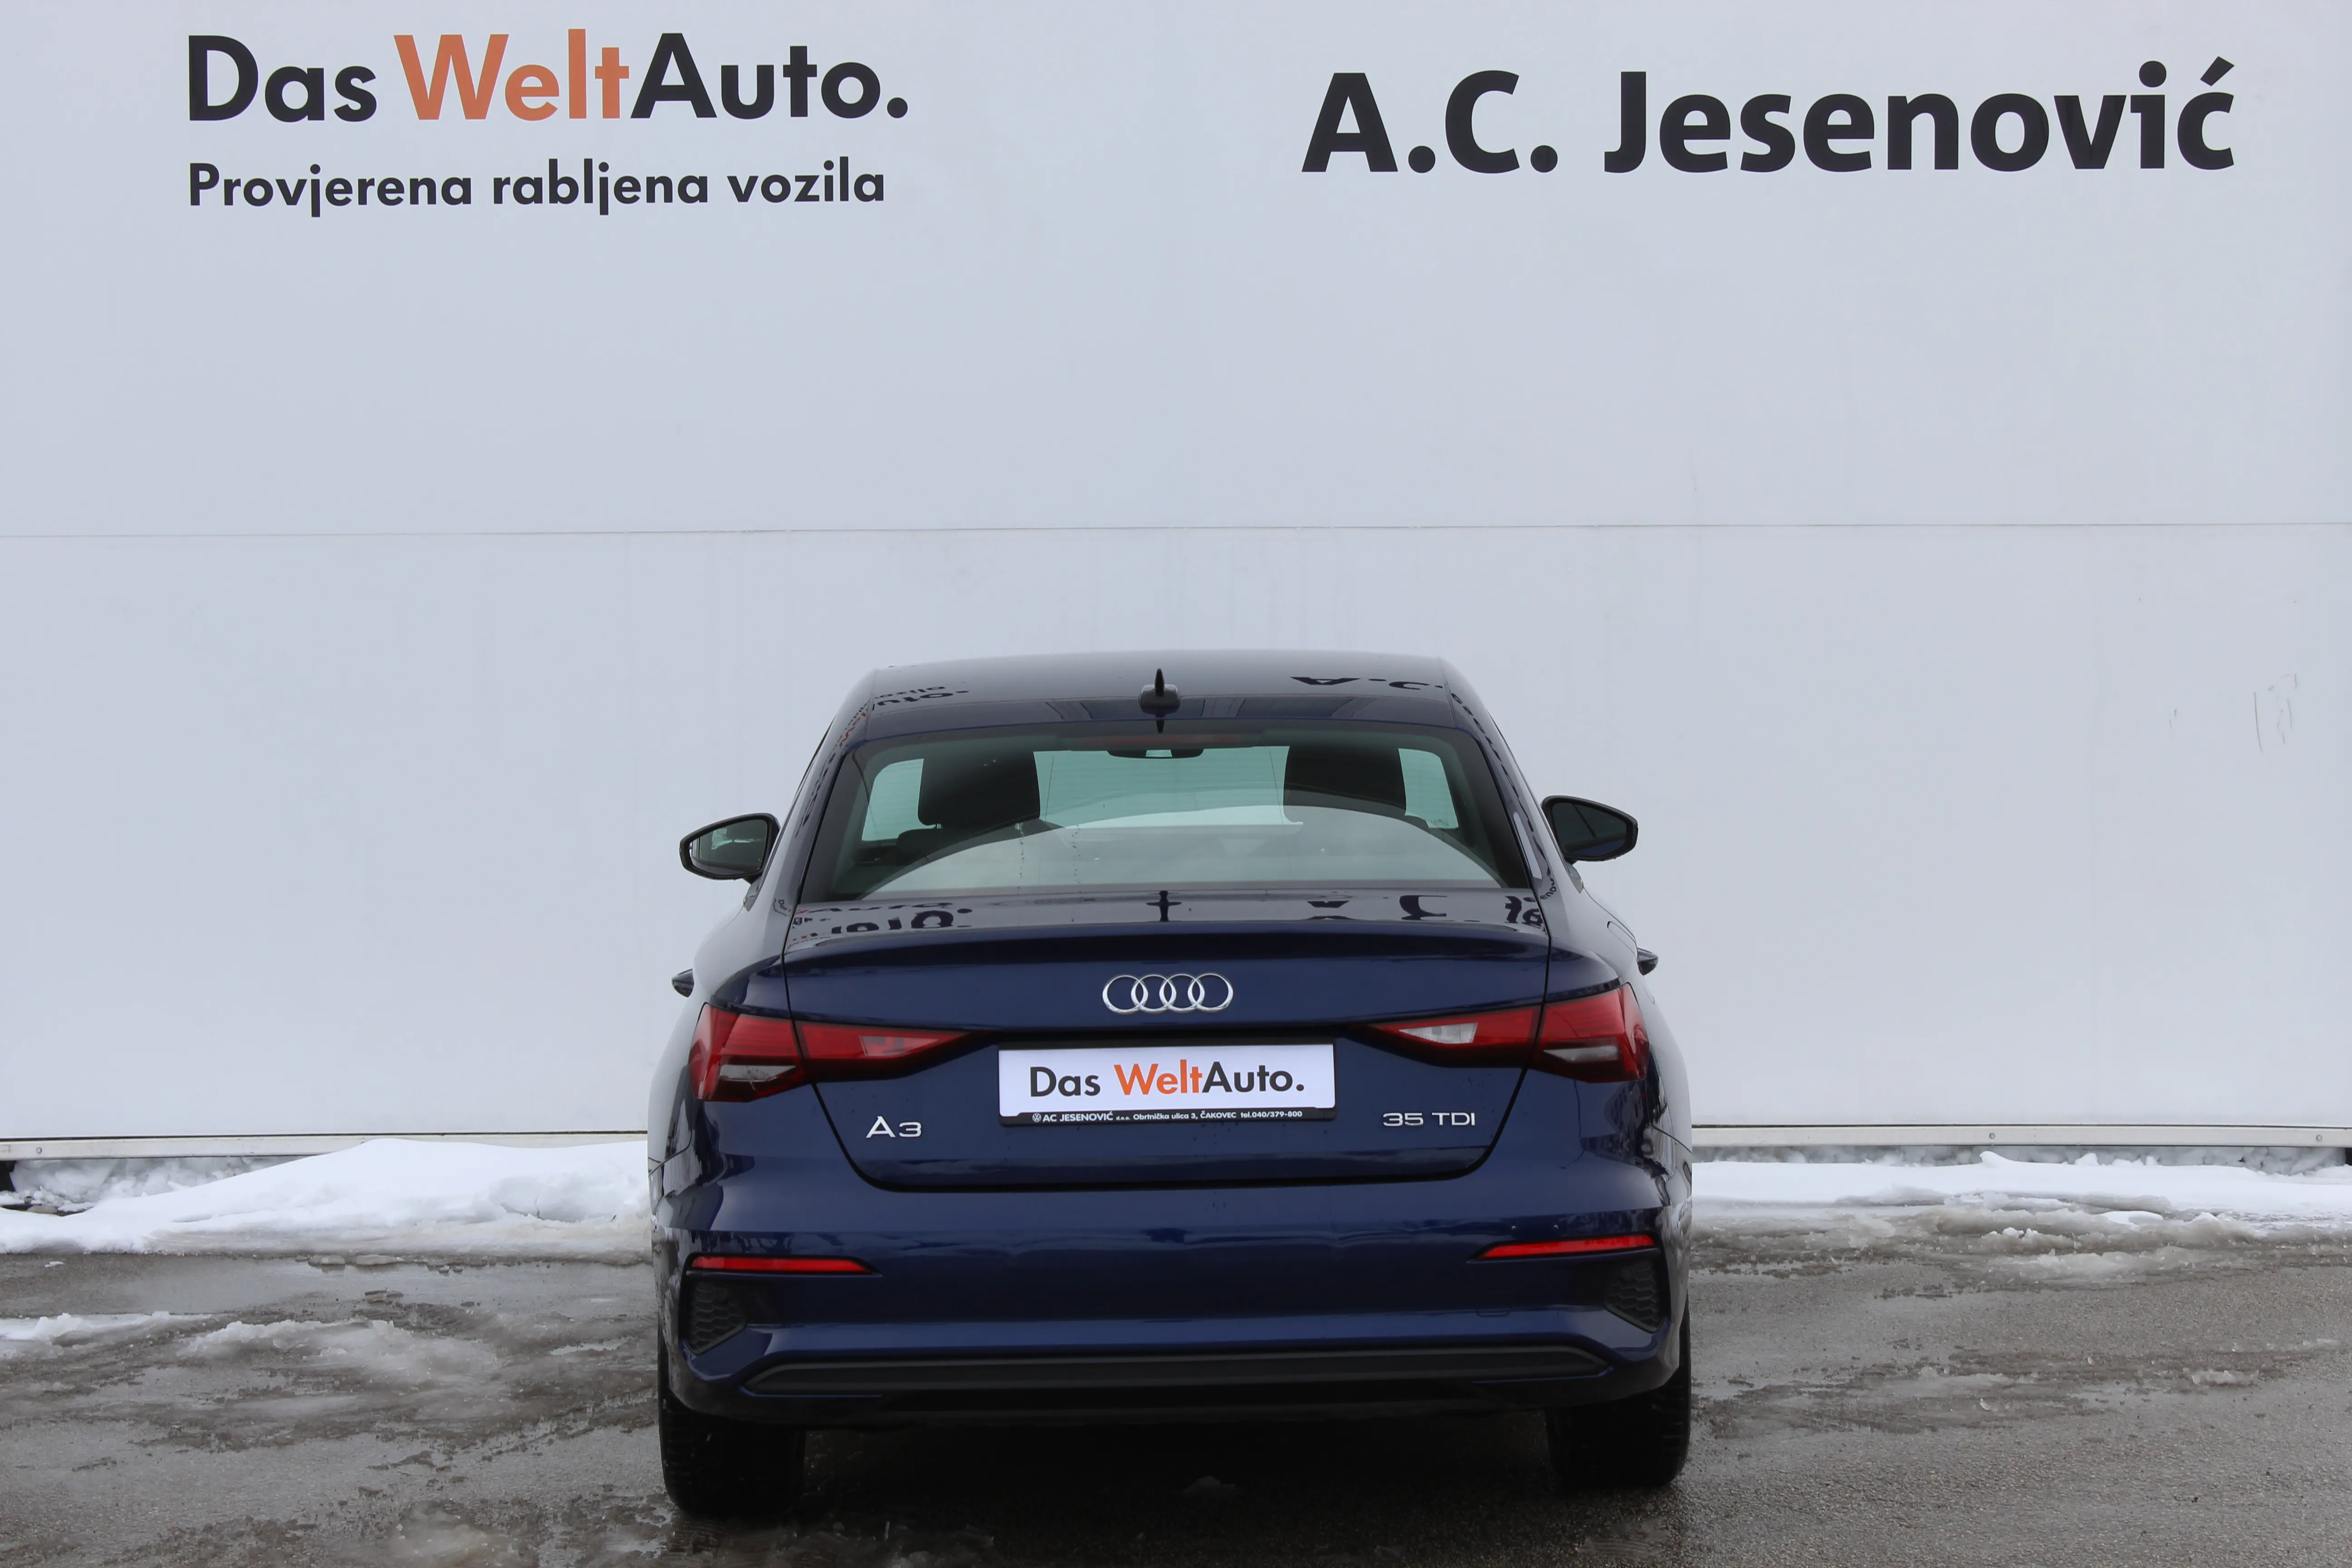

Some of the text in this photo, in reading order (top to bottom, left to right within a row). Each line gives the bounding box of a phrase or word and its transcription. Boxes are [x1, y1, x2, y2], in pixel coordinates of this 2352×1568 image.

[188, 29, 908, 122] Das WeltAuto.
[1301, 56, 2234, 174] A.C. Jesenović
[190, 156, 884, 217] Provjerena rabljena vozila
[1030, 1059, 1305, 1097] Das WeltAuto.
[1059, 1111, 1113, 1122] JESENOVIĆ
[1200, 1111, 1236, 1119] ČAKOVEC
[1383, 1112, 1475, 1126] 35 TDI
